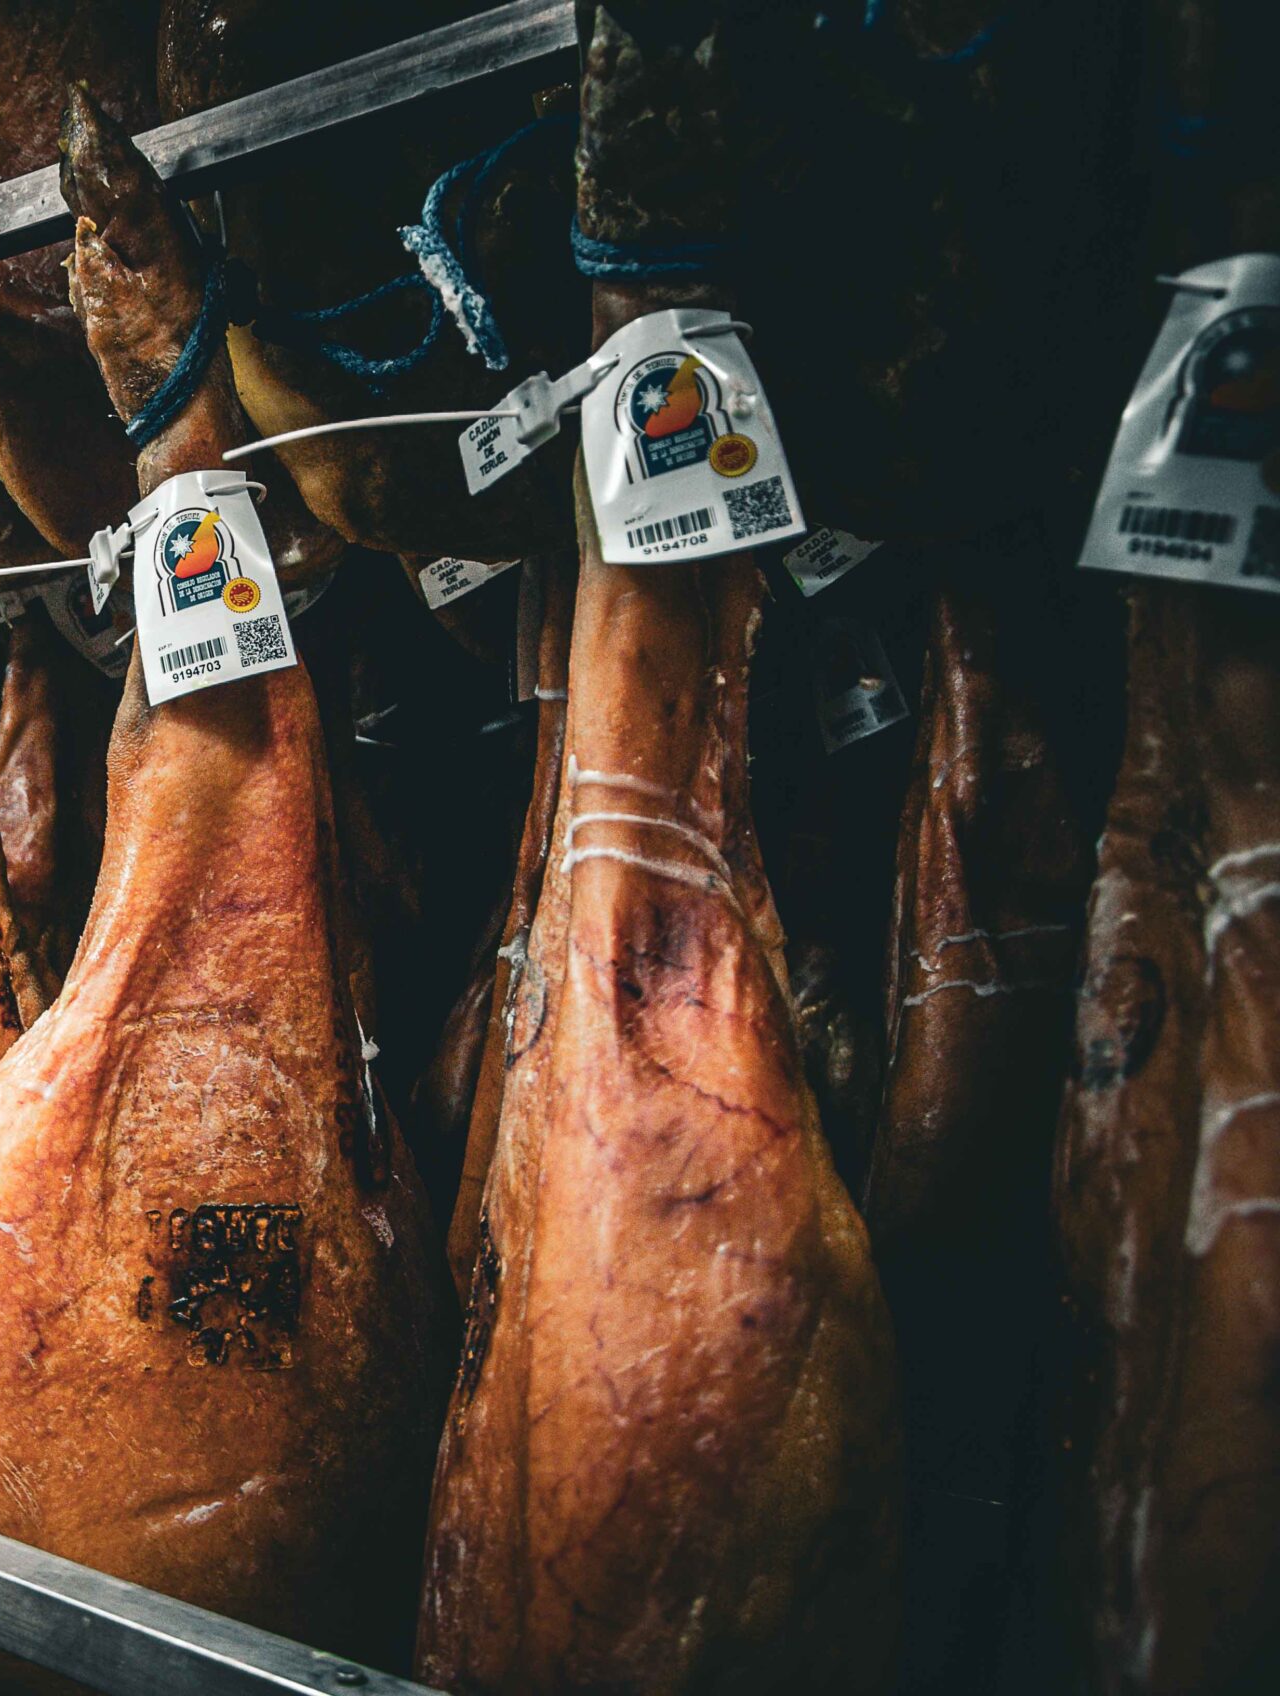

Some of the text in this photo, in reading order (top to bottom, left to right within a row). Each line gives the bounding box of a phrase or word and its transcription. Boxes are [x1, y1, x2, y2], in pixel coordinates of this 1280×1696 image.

[483, 444, 495, 459] DE
[479, 451, 508, 476] TERUEL
[643, 533, 708, 555] 9194708
[441, 577, 471, 598] TERUEL
[446, 574, 458, 585] DE
[172, 660, 222, 683] 9194703
